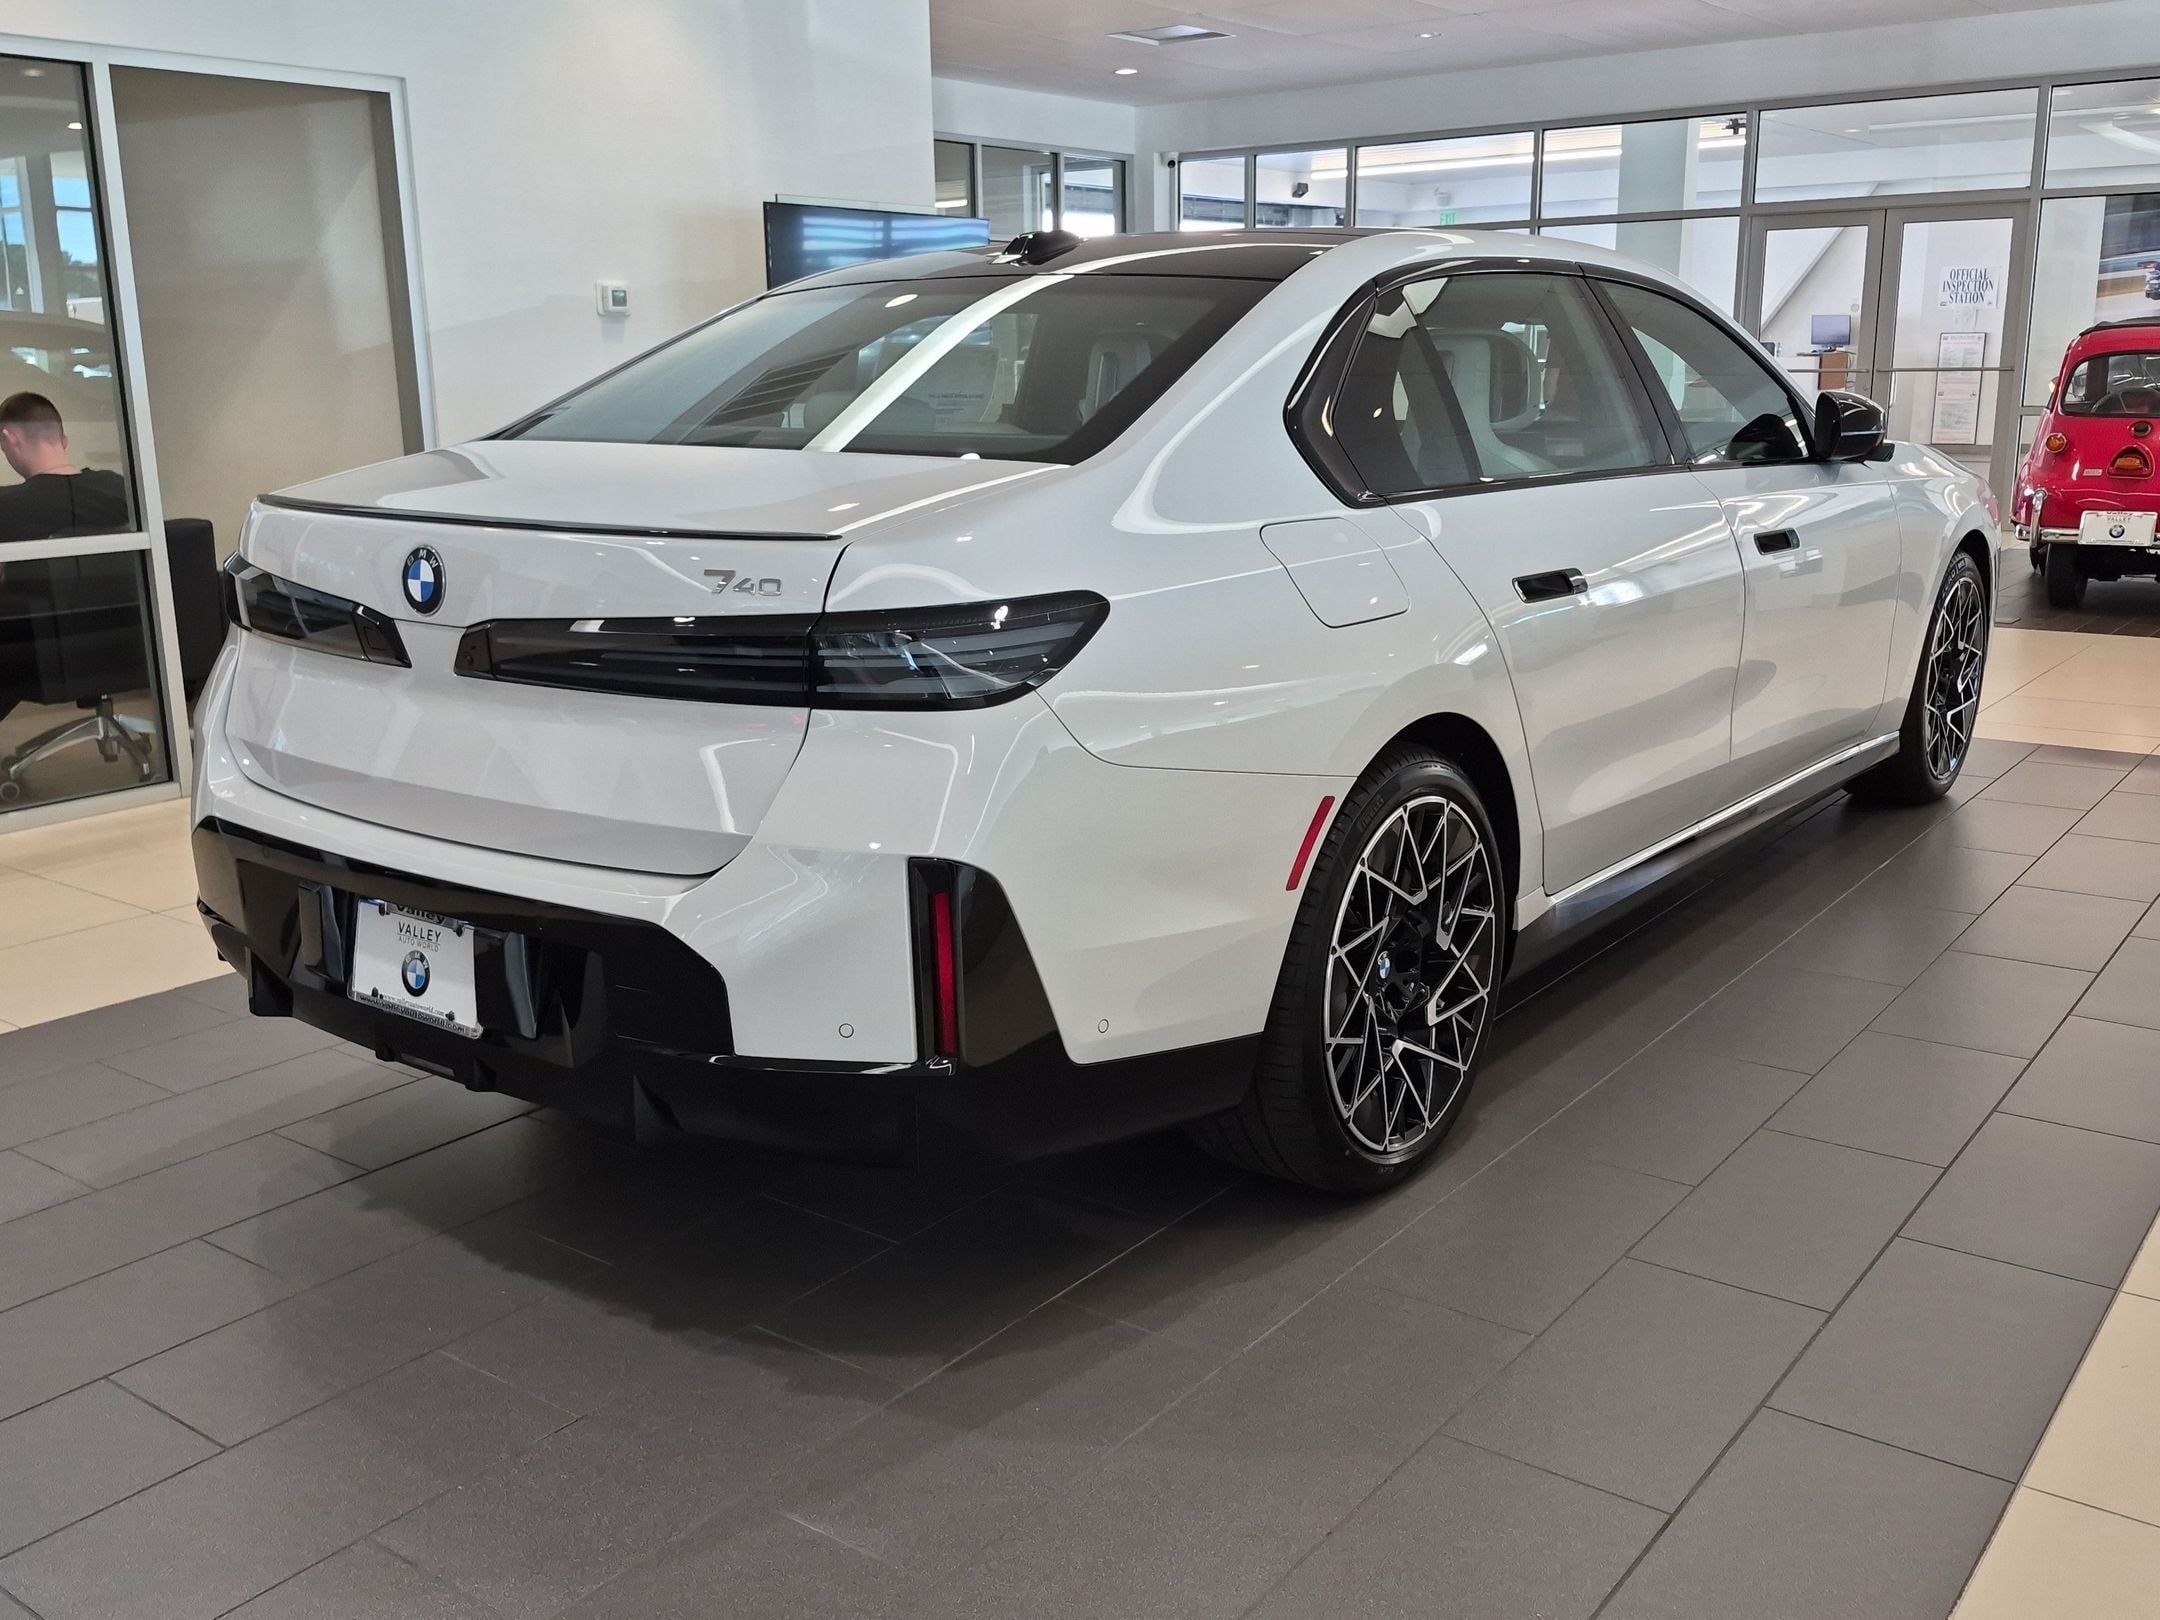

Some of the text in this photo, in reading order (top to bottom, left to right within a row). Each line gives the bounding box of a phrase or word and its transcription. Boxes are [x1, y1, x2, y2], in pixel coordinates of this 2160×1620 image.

[1950, 267, 1989, 280] OFFICIAL
[1943, 279, 1994, 292] INSPECTION
[1949, 291, 1985, 304] STATION
[407, 549, 439, 569] BMW
[703, 569, 782, 597] 740
[397, 903, 445, 925] Valley
[398, 921, 441, 942] VALLEY
[399, 935, 439, 952] AUTO WORLD
[405, 951, 429, 969] BMW
